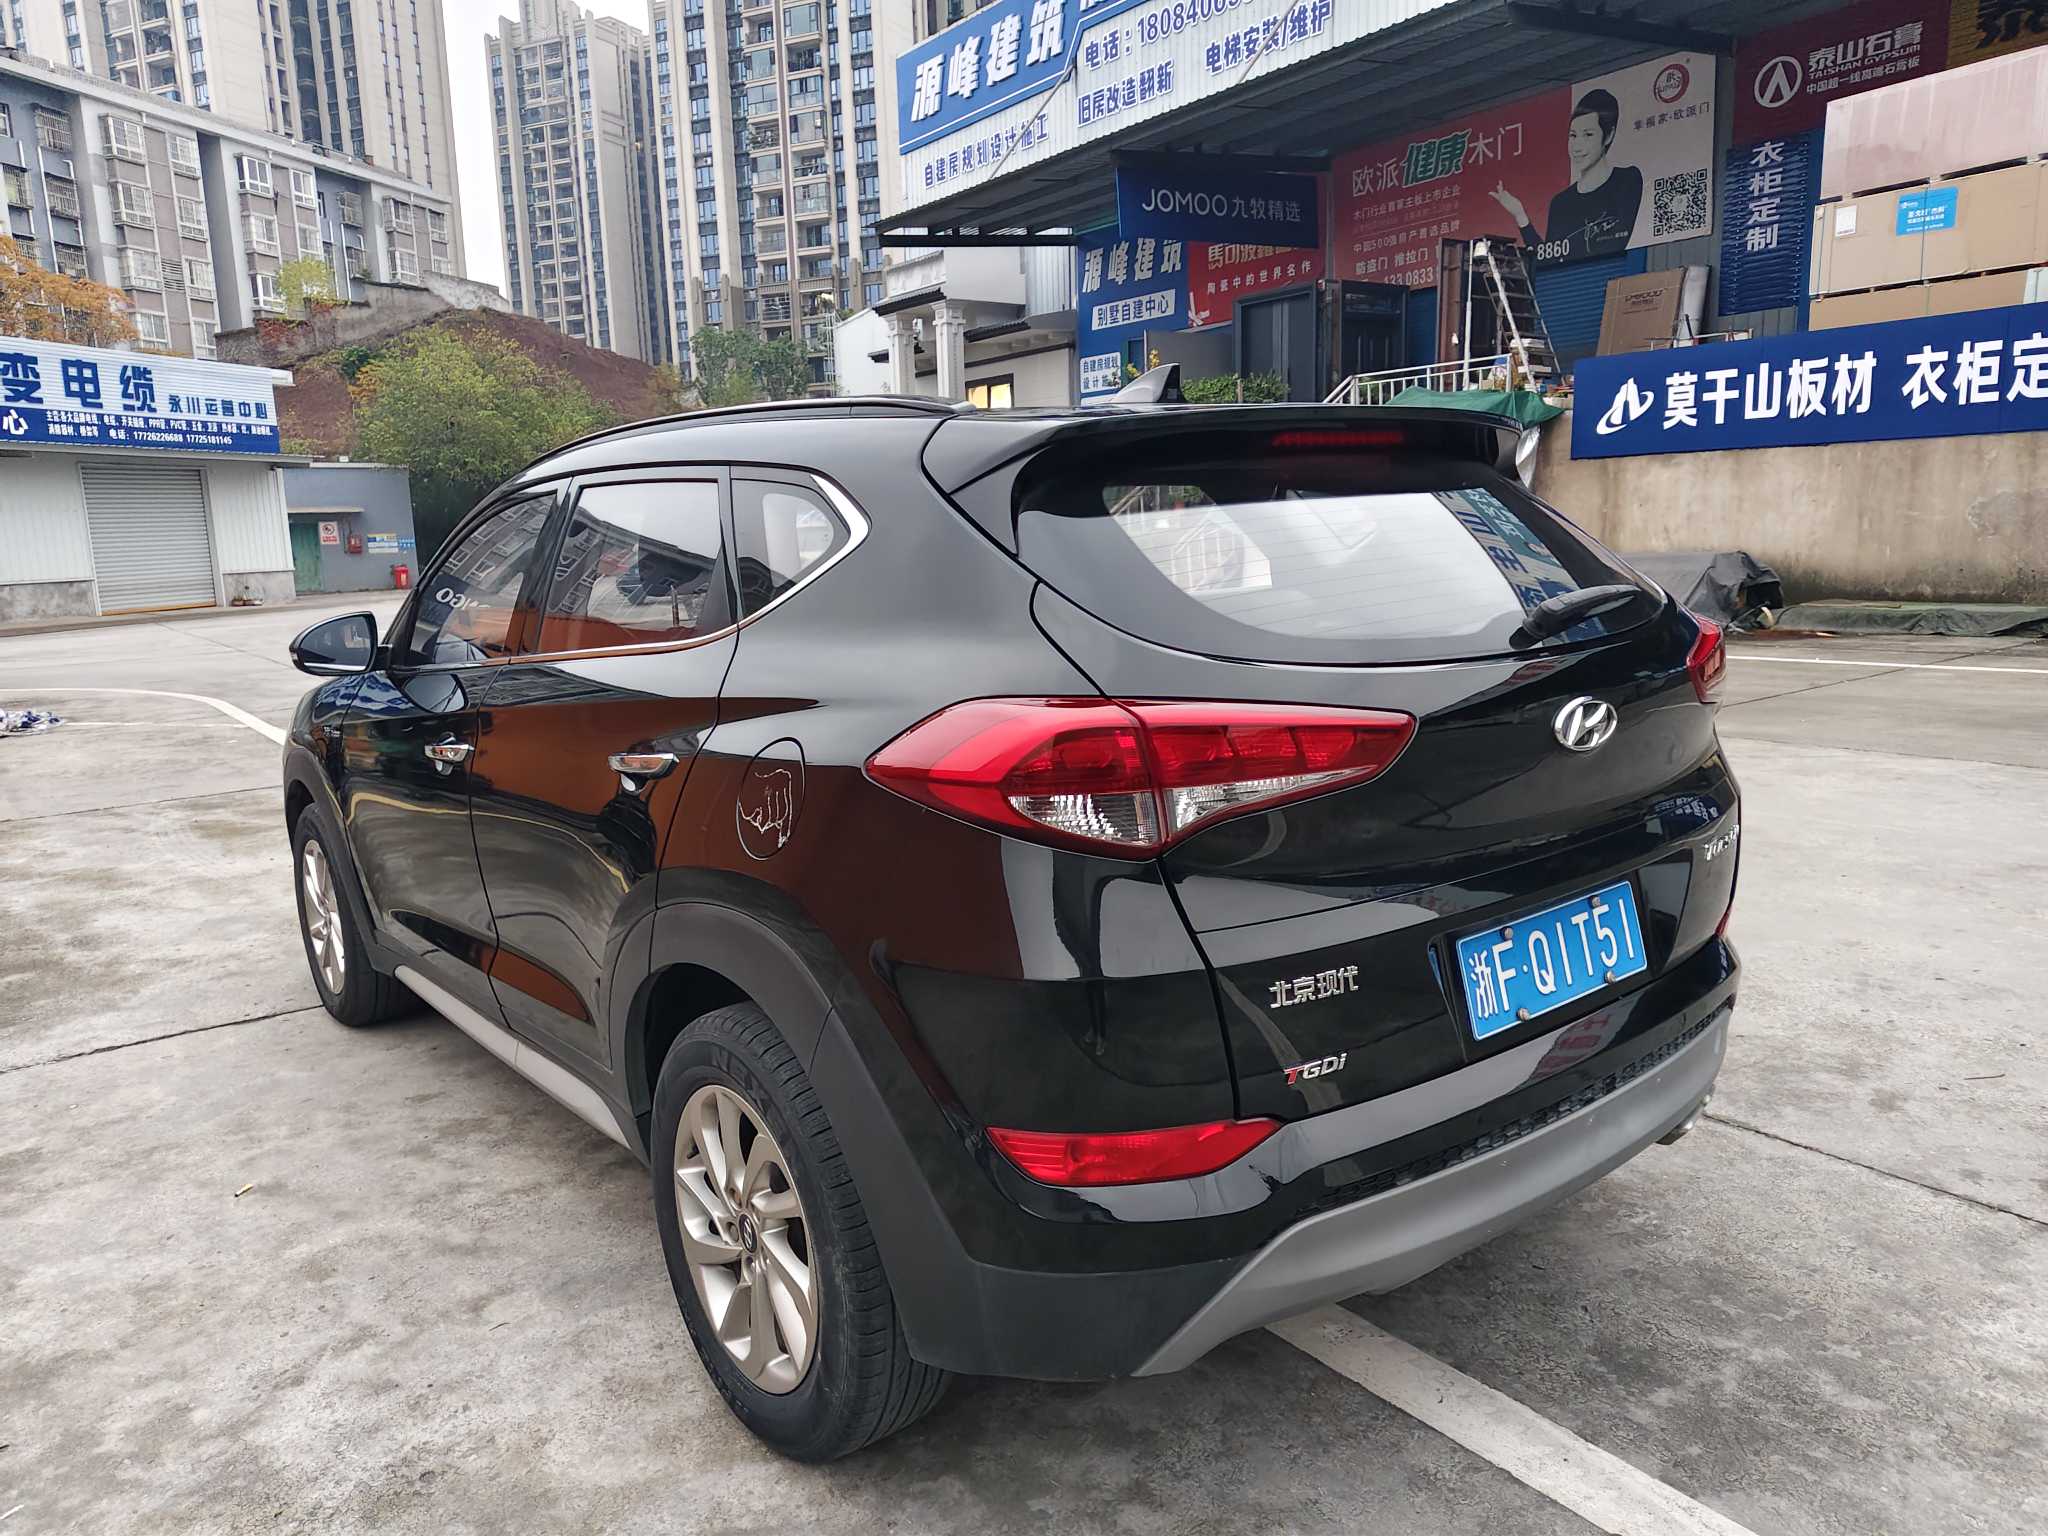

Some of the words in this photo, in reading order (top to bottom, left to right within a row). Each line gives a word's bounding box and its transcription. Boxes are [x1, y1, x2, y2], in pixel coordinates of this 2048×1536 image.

[911, 0, 1067, 122] 源峰建筑
[1206, 2, 1332, 72] 电梯安装/维护
[1808, 21, 1923, 72] 泰山石膏
[1078, 62, 1173, 125] 旧房改造翻新
[1809, 60, 1862, 79] TAISHAN
[924, 113, 1048, 187] 自建房规划设计施工
[1352, 122, 1522, 197] 欧派健康木门
[1745, 141, 1785, 252] 衣柜定制
[1082, 237, 1182, 292] 源峰建筑
[1537, 239, 1570, 260] 8860
[1207, 260, 1312, 295] 陶瓷中的世界名作
[1097, 295, 1169, 326] 别墅自建中心
[0, 353, 158, 413] 变电缆
[168, 394, 268, 420] 永川运营中心
[1662, 350, 1878, 430] 莫干山板材
[1901, 332, 2048, 410] 衣柜定
[2, 408, 29, 435] 心
[1268, 965, 1359, 1009] 北京现代
